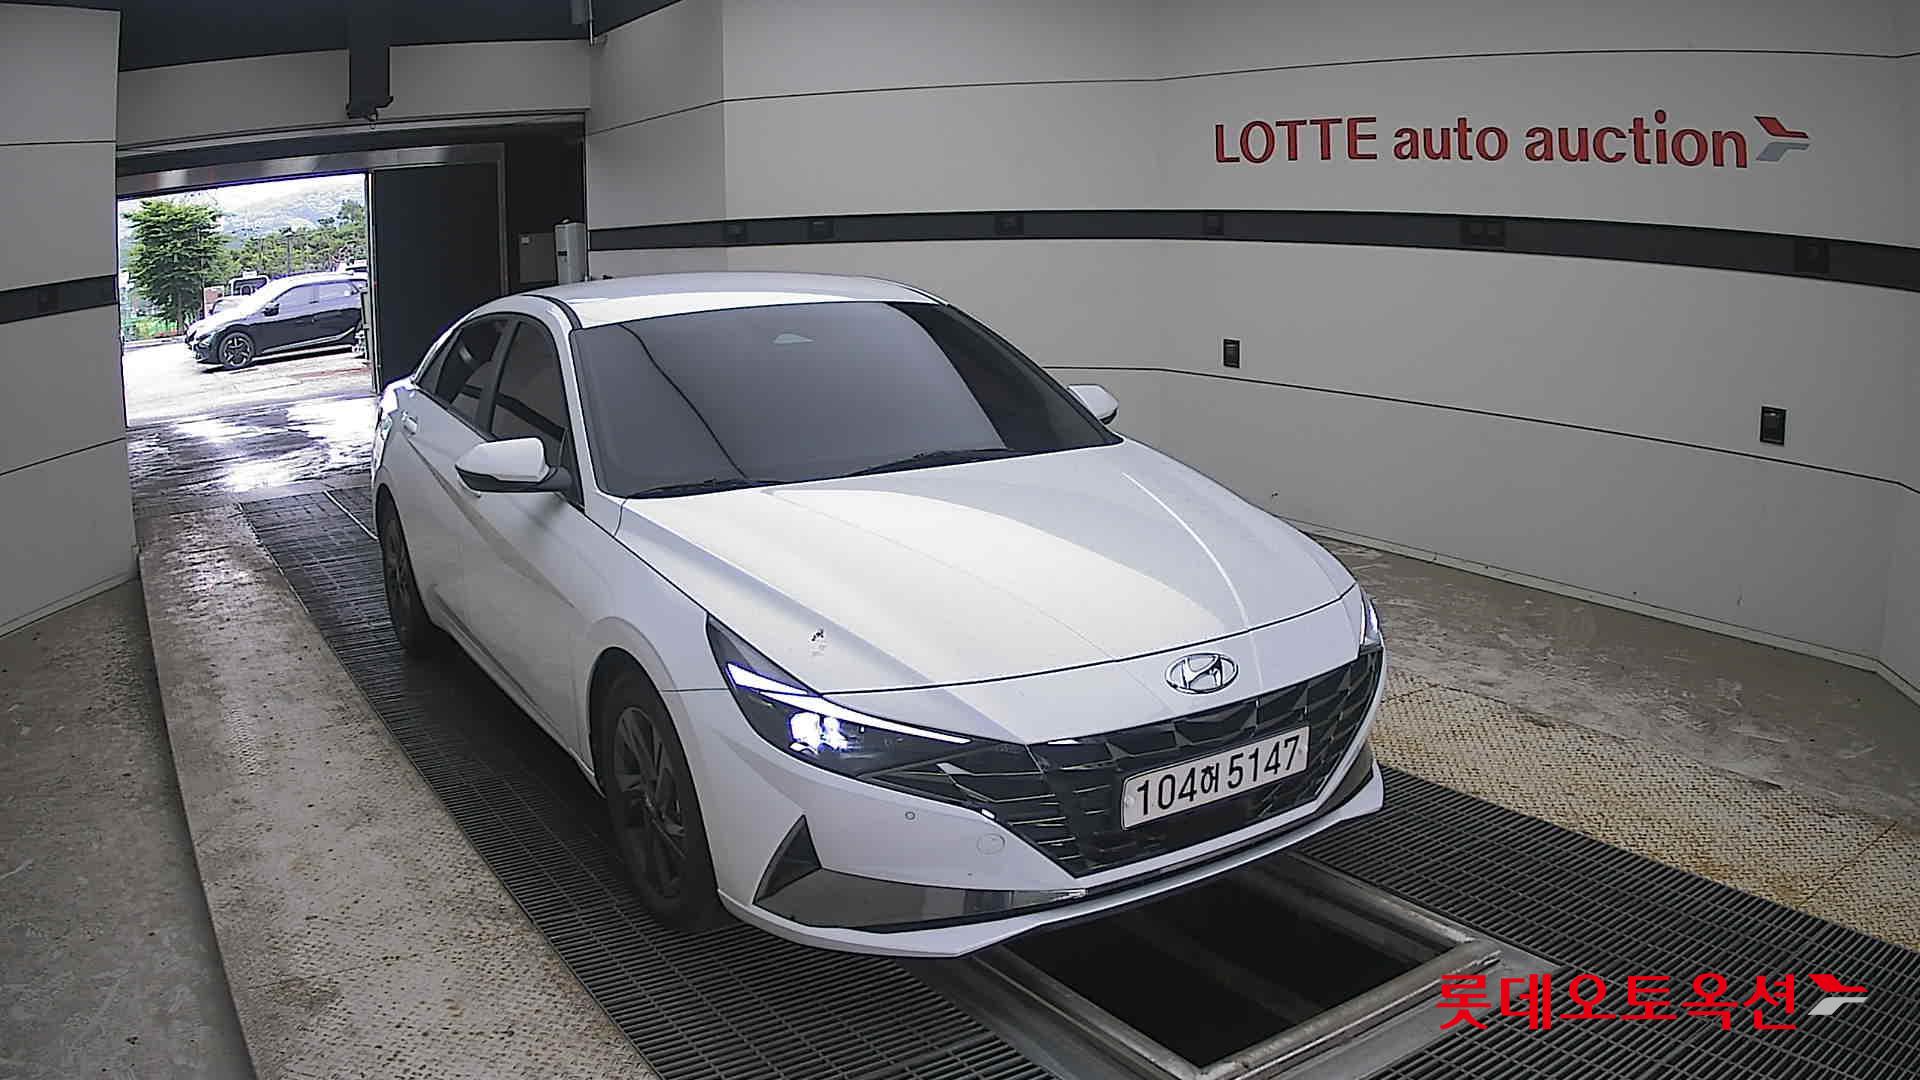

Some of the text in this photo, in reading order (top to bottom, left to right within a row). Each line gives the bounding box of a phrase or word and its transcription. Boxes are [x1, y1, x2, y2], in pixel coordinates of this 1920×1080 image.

[1214, 109, 1748, 169] LOTTE auto auction
[1137, 735, 1300, 816] 104허 5147
